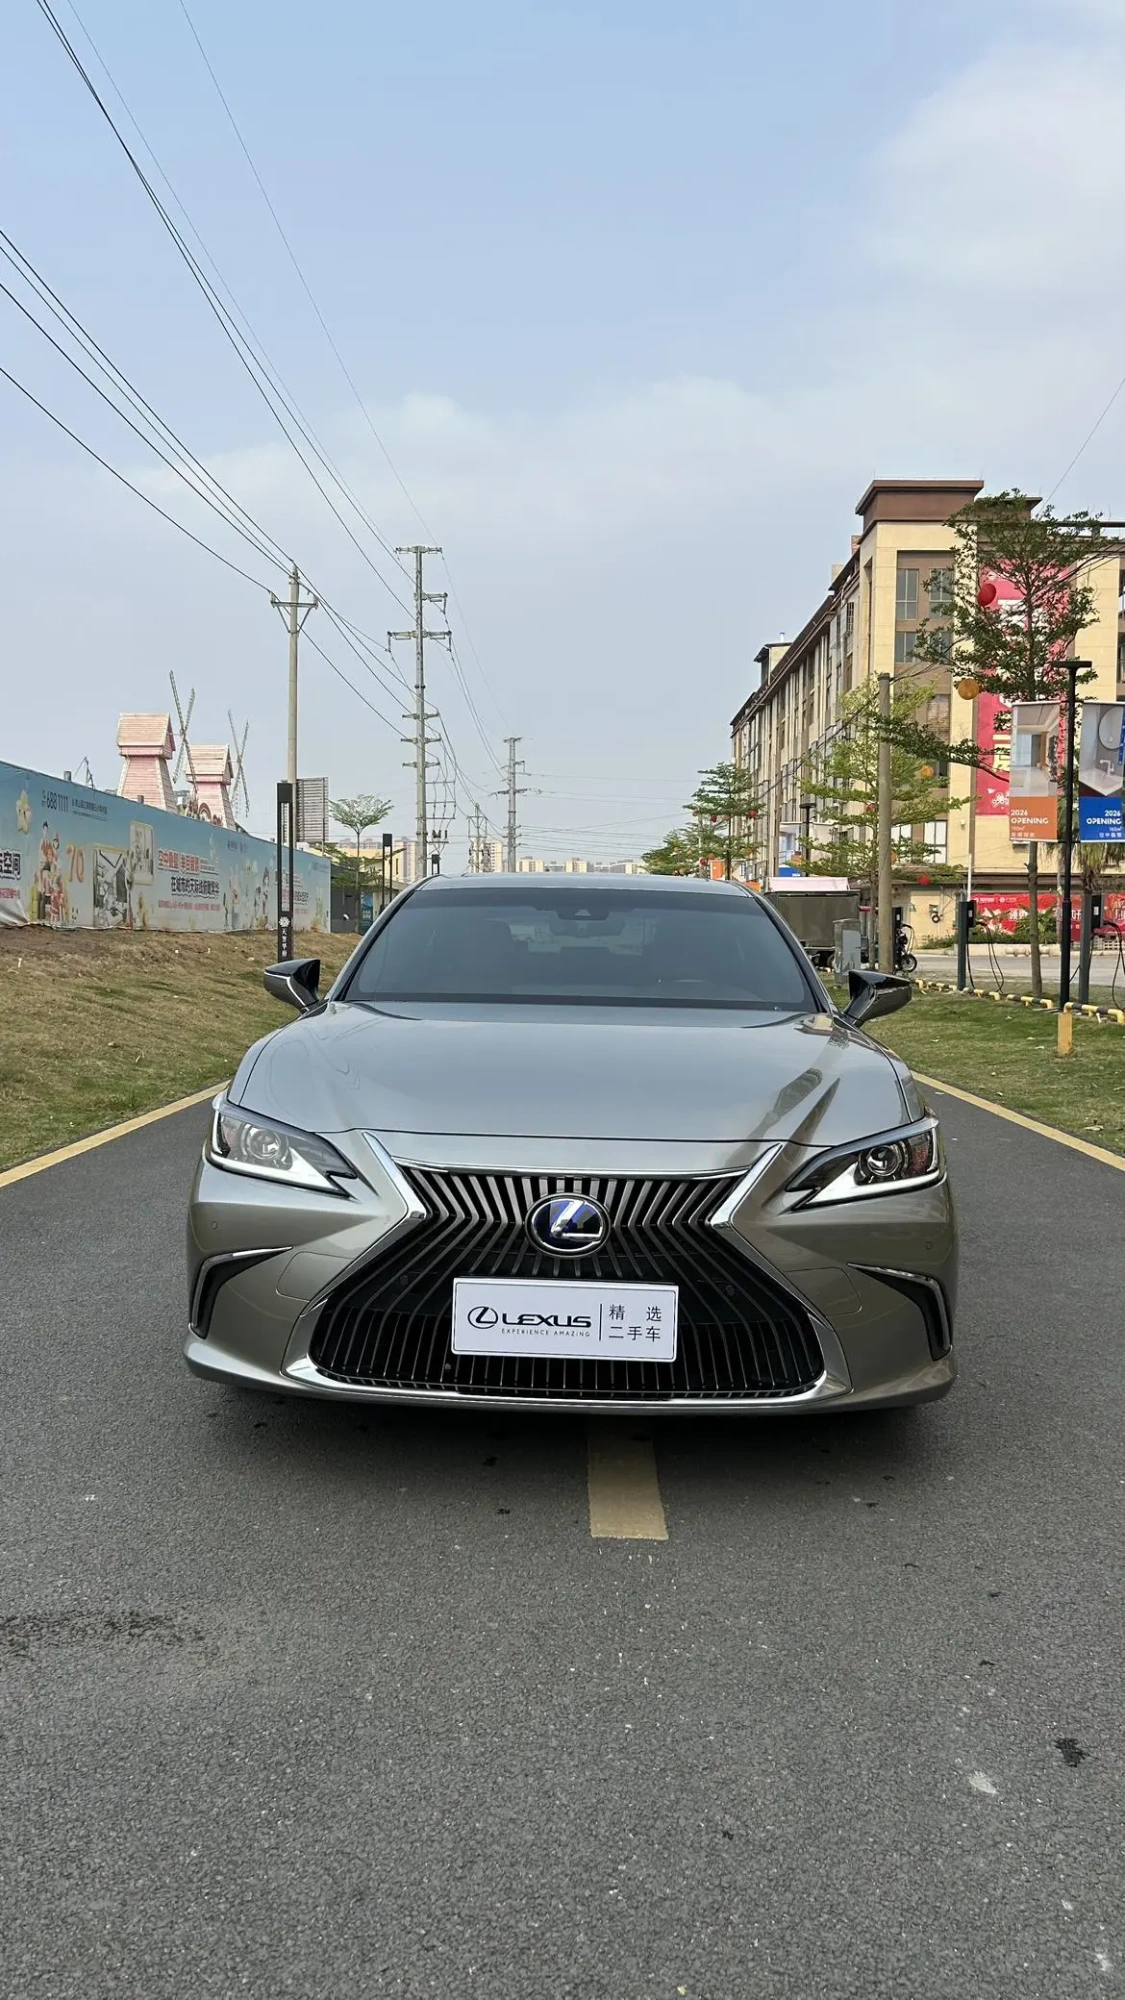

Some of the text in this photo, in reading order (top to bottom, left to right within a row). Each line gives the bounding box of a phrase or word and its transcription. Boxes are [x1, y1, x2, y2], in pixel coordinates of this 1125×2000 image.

[1104, 809, 1121, 817] 2026
[1086, 817, 1122, 825] OPENING
[502, 1313, 592, 1328] LEXUS
[501, 1328, 549, 1336] EXPERIENCE
[608, 1325, 661, 1342] 二手车
